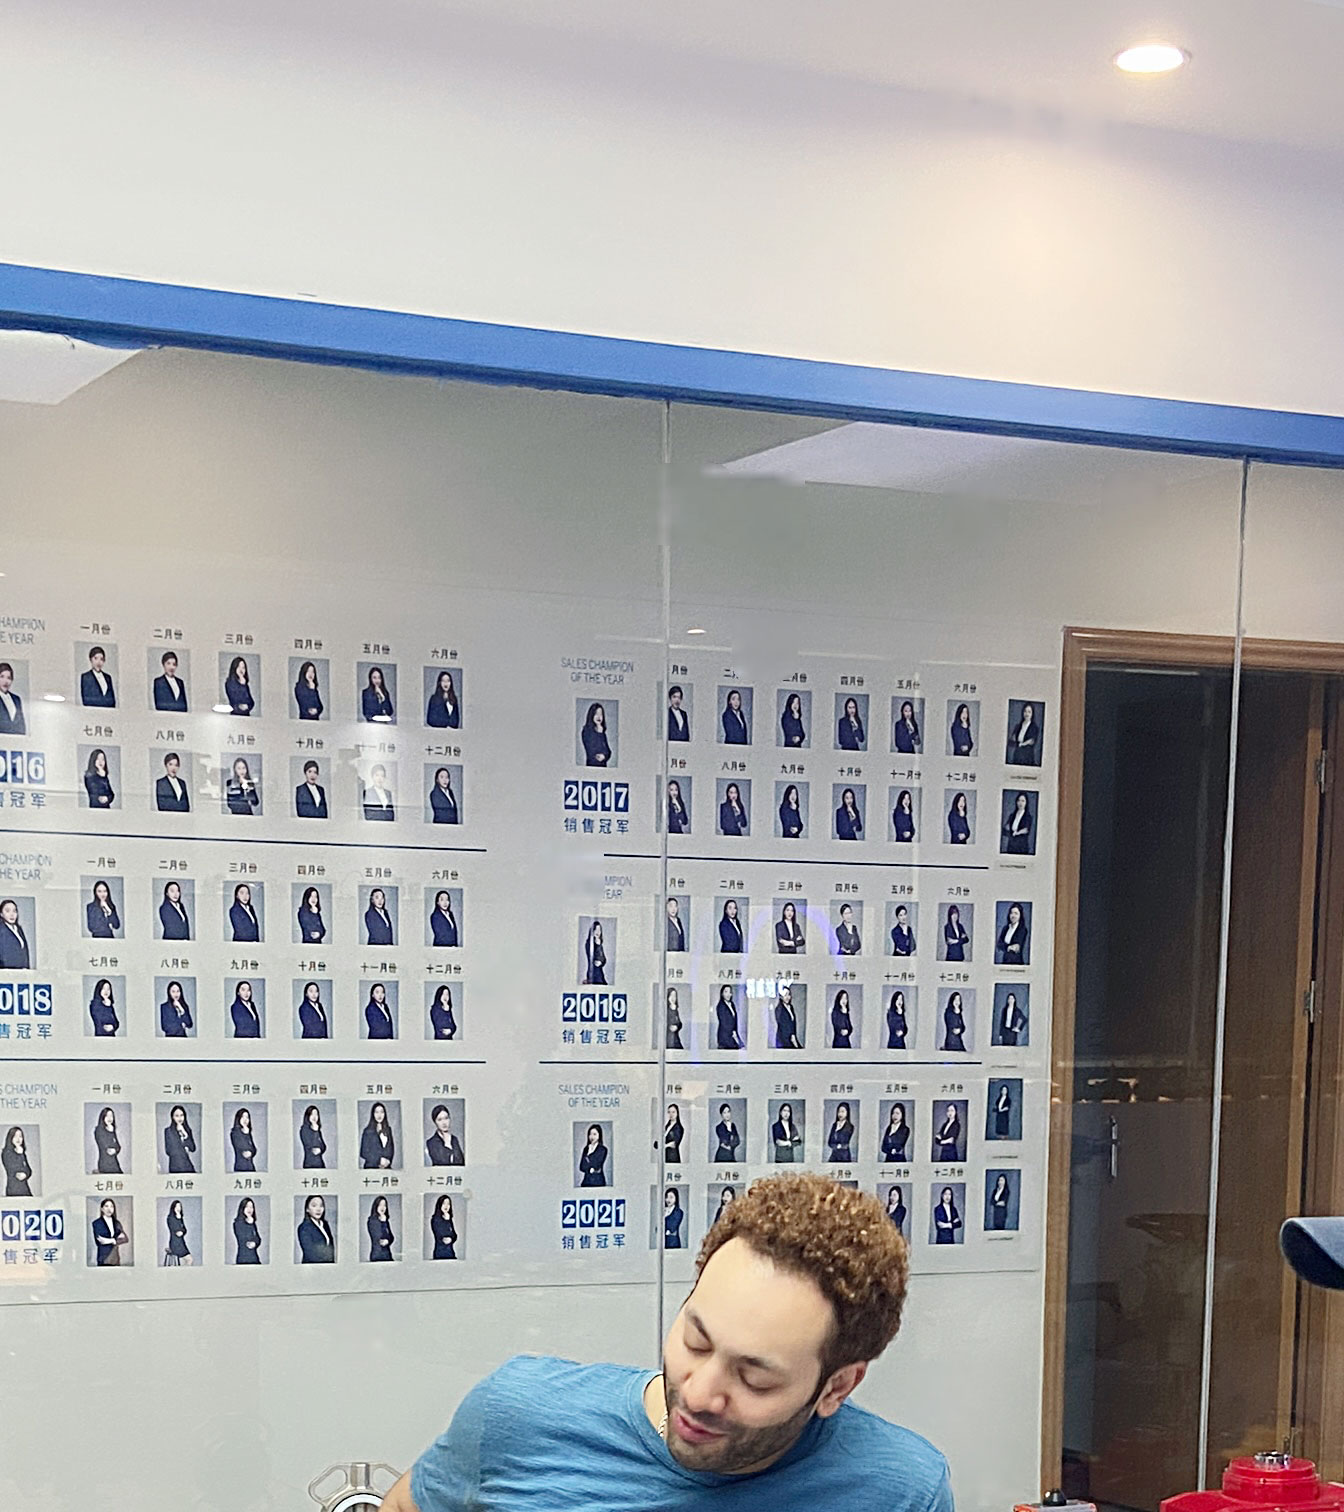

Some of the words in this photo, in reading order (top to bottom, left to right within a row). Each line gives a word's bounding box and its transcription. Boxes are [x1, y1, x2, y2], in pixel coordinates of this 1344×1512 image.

[80, 623, 111, 635] 一月份
[154, 629, 183, 640] 二月份
[225, 634, 253, 645] 三月份
[295, 639, 322, 649] 四月份
[363, 644, 390, 654] 五月份
[431, 649, 458, 659] 六月份
[841, 676, 864, 686] 四月份
[83, 725, 113, 737] 七月份
[156, 730, 184, 741] 八月份
[227, 734, 255, 746] 九月份
[296, 738, 323, 749] 十月份
[425, 746, 461, 756] 十二月份
[722, 761, 746, 771] 八月份
[781, 764, 804, 774] 九月份
[838, 767, 862, 776] 十月份
[890, 770, 921, 779] 十一月份
[946, 773, 976, 782] 十二月份
[564, 783, 629, 810] 2017
[564, 817, 629, 834] 销售冠军
[87, 857, 116, 868] 一月份
[159, 860, 187, 870] 二月份
[229, 863, 257, 873] 三月份
[298, 865, 325, 875] 四月份
[365, 868, 392, 877] 五月份
[432, 870, 458, 880] 六月份
[720, 880, 744, 889] 二月份
[778, 882, 802, 891] 三月份
[836, 884, 858, 892] 四月份
[891, 885, 913, 894] 五月份
[948, 887, 970, 896] 六月份
[89, 957, 118, 967] 七月份
[161, 958, 189, 968] 八月份
[231, 960, 259, 970] 九月份
[298, 961, 326, 971] 十月份
[361, 963, 397, 973] 十一月份
[426, 964, 461, 974] 十二月份
[718, 970, 742, 979] 八月份
[833, 971, 856, 980] 十月份
[884, 972, 915, 981] 十一月份
[939, 973, 969, 982] 十二月份
[562, 995, 627, 1020] 2019
[562, 1028, 627, 1044] 销售冠军
[92, 1084, 121, 1093] 一月份
[163, 1084, 191, 1094] 二月份
[233, 1084, 260, 1094] 三月份
[300, 1084, 327, 1094] 四月份
[367, 1085, 392, 1094] 五月份
[433, 1085, 459, 1094] 六月份
[716, 1084, 740, 1093] 二月份
[774, 1084, 798, 1093] 三月份
[831, 1084, 853, 1093] 四月份
[886, 1084, 908, 1093] 五月份
[942, 1084, 963, 1092] 六月份
[716, 1172, 739, 1180] 八月份
[880, 1169, 909, 1177] 十一月份
[934, 1168, 963, 1176] 十二月份
[166, 1180, 193, 1189] 八月份
[234, 1179, 262, 1189] 九月份
[301, 1178, 328, 1187] 十月份
[363, 1177, 398, 1187] 十一月份
[427, 1176, 462, 1185] 十二月份
[95, 1181, 123, 1191] 七月份
[562, 1201, 624, 1226] 2021
[562, 1232, 626, 1249] 销售冠军
